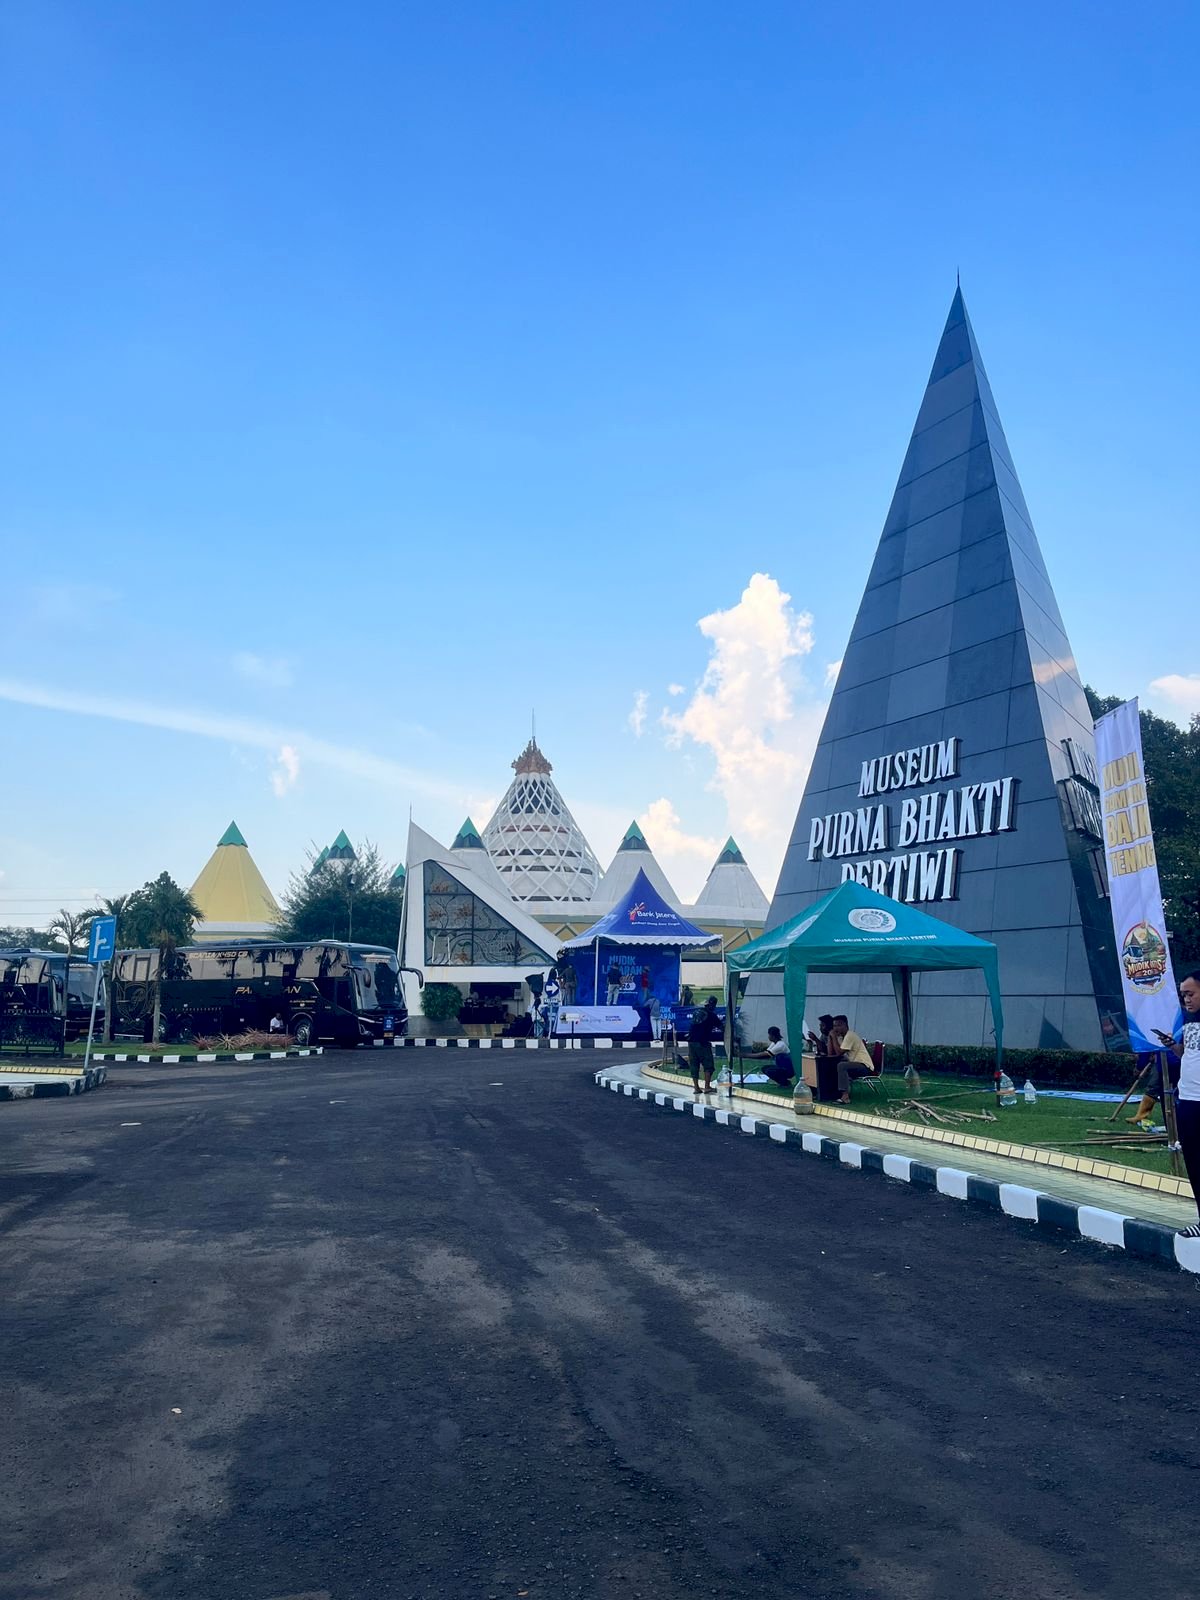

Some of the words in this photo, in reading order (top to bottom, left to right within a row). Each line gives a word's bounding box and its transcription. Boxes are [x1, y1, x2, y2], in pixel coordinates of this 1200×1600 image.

[857, 736, 957, 797] MUSEUM
[806, 803, 888, 861] PURNA
[897, 776, 1015, 847] BHAKTI
[655, 911, 677, 920] Jateng
